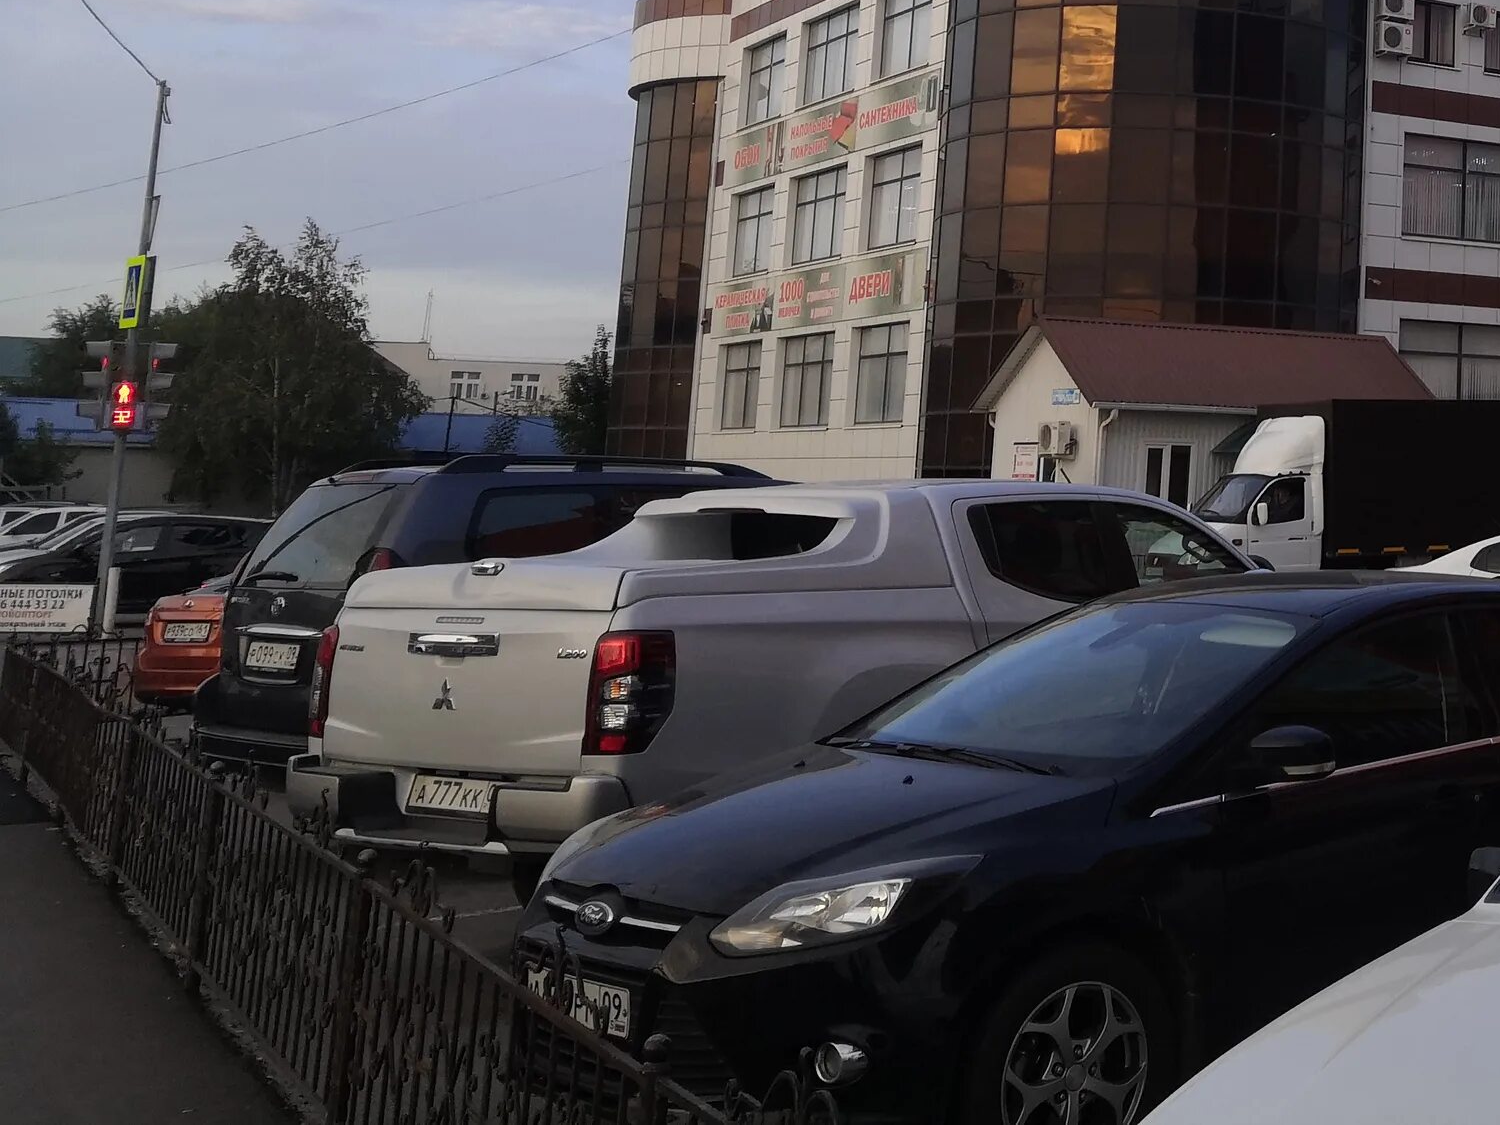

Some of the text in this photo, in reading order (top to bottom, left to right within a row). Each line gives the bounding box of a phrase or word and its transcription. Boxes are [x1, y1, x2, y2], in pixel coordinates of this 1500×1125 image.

[859, 96, 918, 130] САНТЕХНИКА
[734, 142, 761, 170] ОБОИ
[779, 278, 805, 303] 1000
[849, 270, 893, 304] ДВЕРИ
[10, 600, 31, 609] 444
[34, 600, 48, 609] 33
[52, 600, 65, 609] 22
[27, 589, 83, 599] ПОТОЛКИ
[556, 647, 588, 659] L200
[416, 779, 483, 809] А777КК
